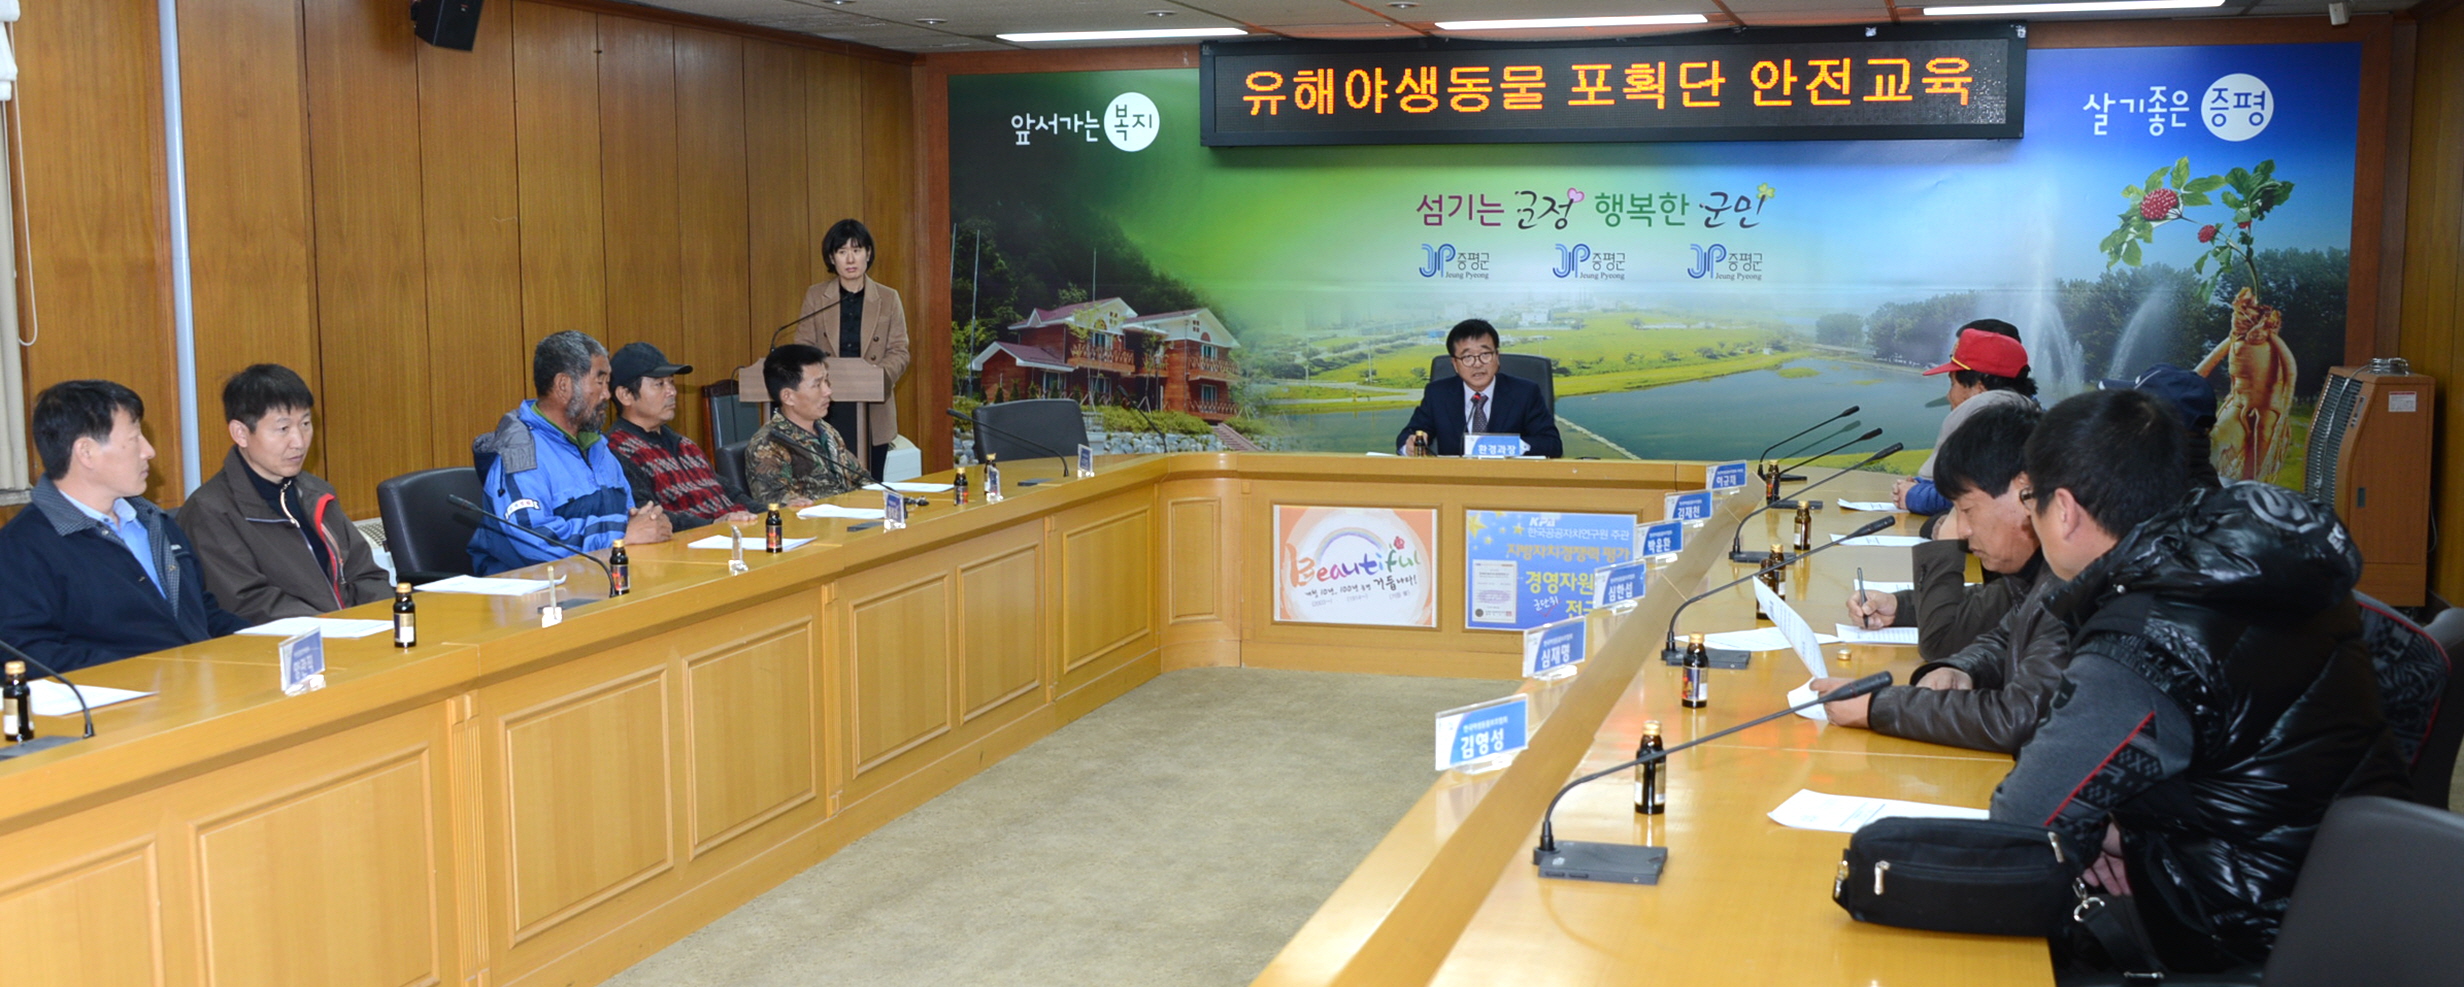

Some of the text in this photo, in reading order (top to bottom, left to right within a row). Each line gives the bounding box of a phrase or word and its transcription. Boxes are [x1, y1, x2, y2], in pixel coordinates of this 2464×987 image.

[1243, 57, 1974, 117] 유해야생동물 포획단 안전교육
[2083, 86, 2266, 136] 살기좋은 증평
[1011, 104, 1152, 145] 앞서가는 복지
[1416, 194, 1505, 227] 섬기는
[1594, 192, 1691, 228] 행복한
[1699, 191, 1766, 228] 군민
[1457, 252, 1490, 271] 증평군
[1592, 252, 1626, 271] 증평군
[1728, 252, 1763, 272] 증평군
[1445, 271, 1489, 280] Jeung Pyeong
[1580, 271, 1625, 280] Jeung Pyeong
[1715, 272, 1762, 281] Jeung Pyeong
[1478, 444, 1516, 455] 환경과장
[1528, 527, 1630, 540] 한국공공자치연구원 주관
[1506, 543, 1631, 564] 지방자치경쟁력 평가
[1285, 543, 1421, 587] Beautiful
[1525, 571, 1595, 595] 경영자원
[1460, 728, 1504, 759] 김영성
